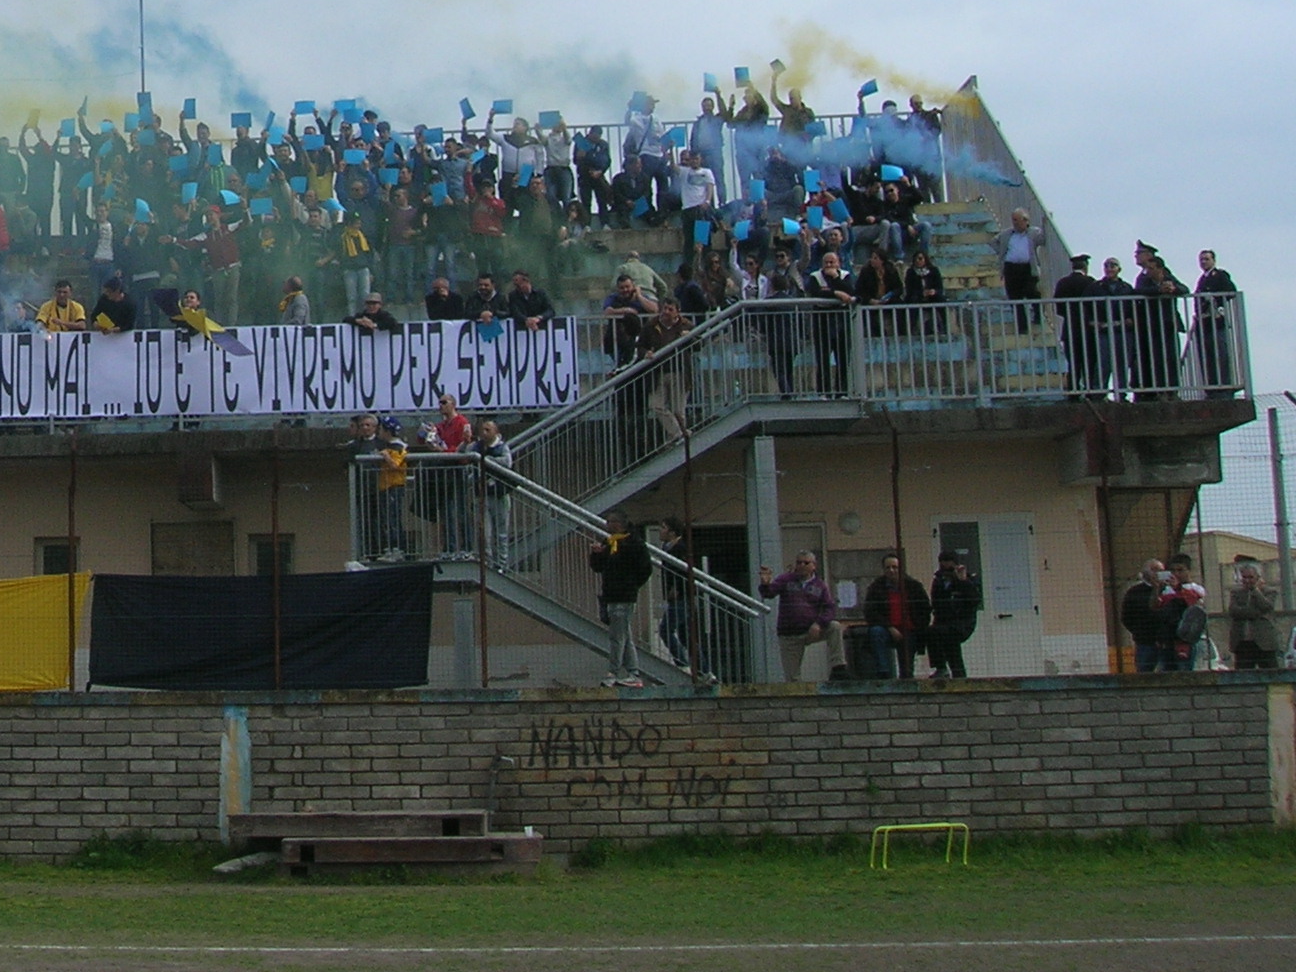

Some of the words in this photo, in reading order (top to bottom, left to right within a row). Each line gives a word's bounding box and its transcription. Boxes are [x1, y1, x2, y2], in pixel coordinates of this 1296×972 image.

[133, 330, 162, 414] IO
[174, 328, 192, 414] E
[204, 328, 240, 414] TE
[253, 322, 378, 413] VIVREMO
[391, 319, 445, 409] PER
[457, 316, 578, 407] SEMPRE!
[527, 714, 663, 768] NANDO
